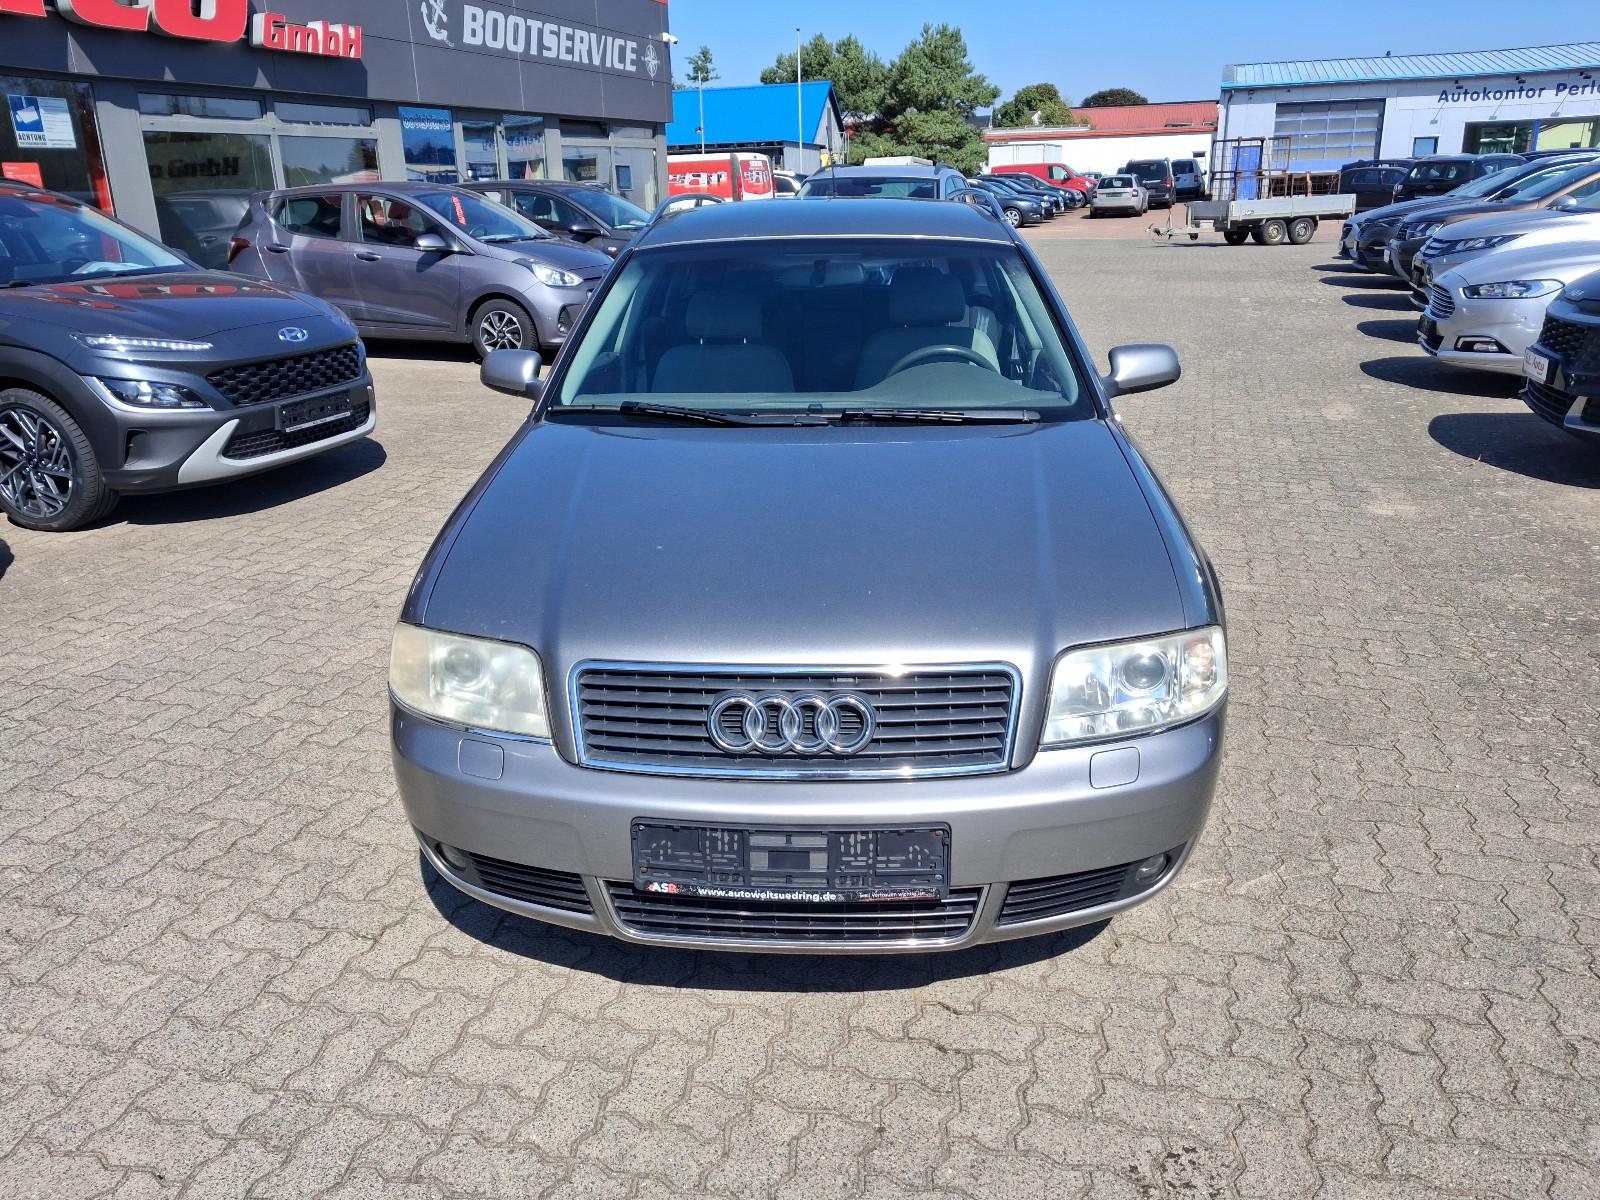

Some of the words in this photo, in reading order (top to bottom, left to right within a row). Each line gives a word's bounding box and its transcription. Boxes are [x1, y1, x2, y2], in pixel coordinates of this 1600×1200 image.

[259, 12, 362, 59] GmbH
[463, 4, 638, 72] BOOTSERVICE
[1438, 86, 1546, 103] Autokontor
[651, 881, 678, 895] ASB
[698, 888, 837, 902] www.autoweltsuedring.de
